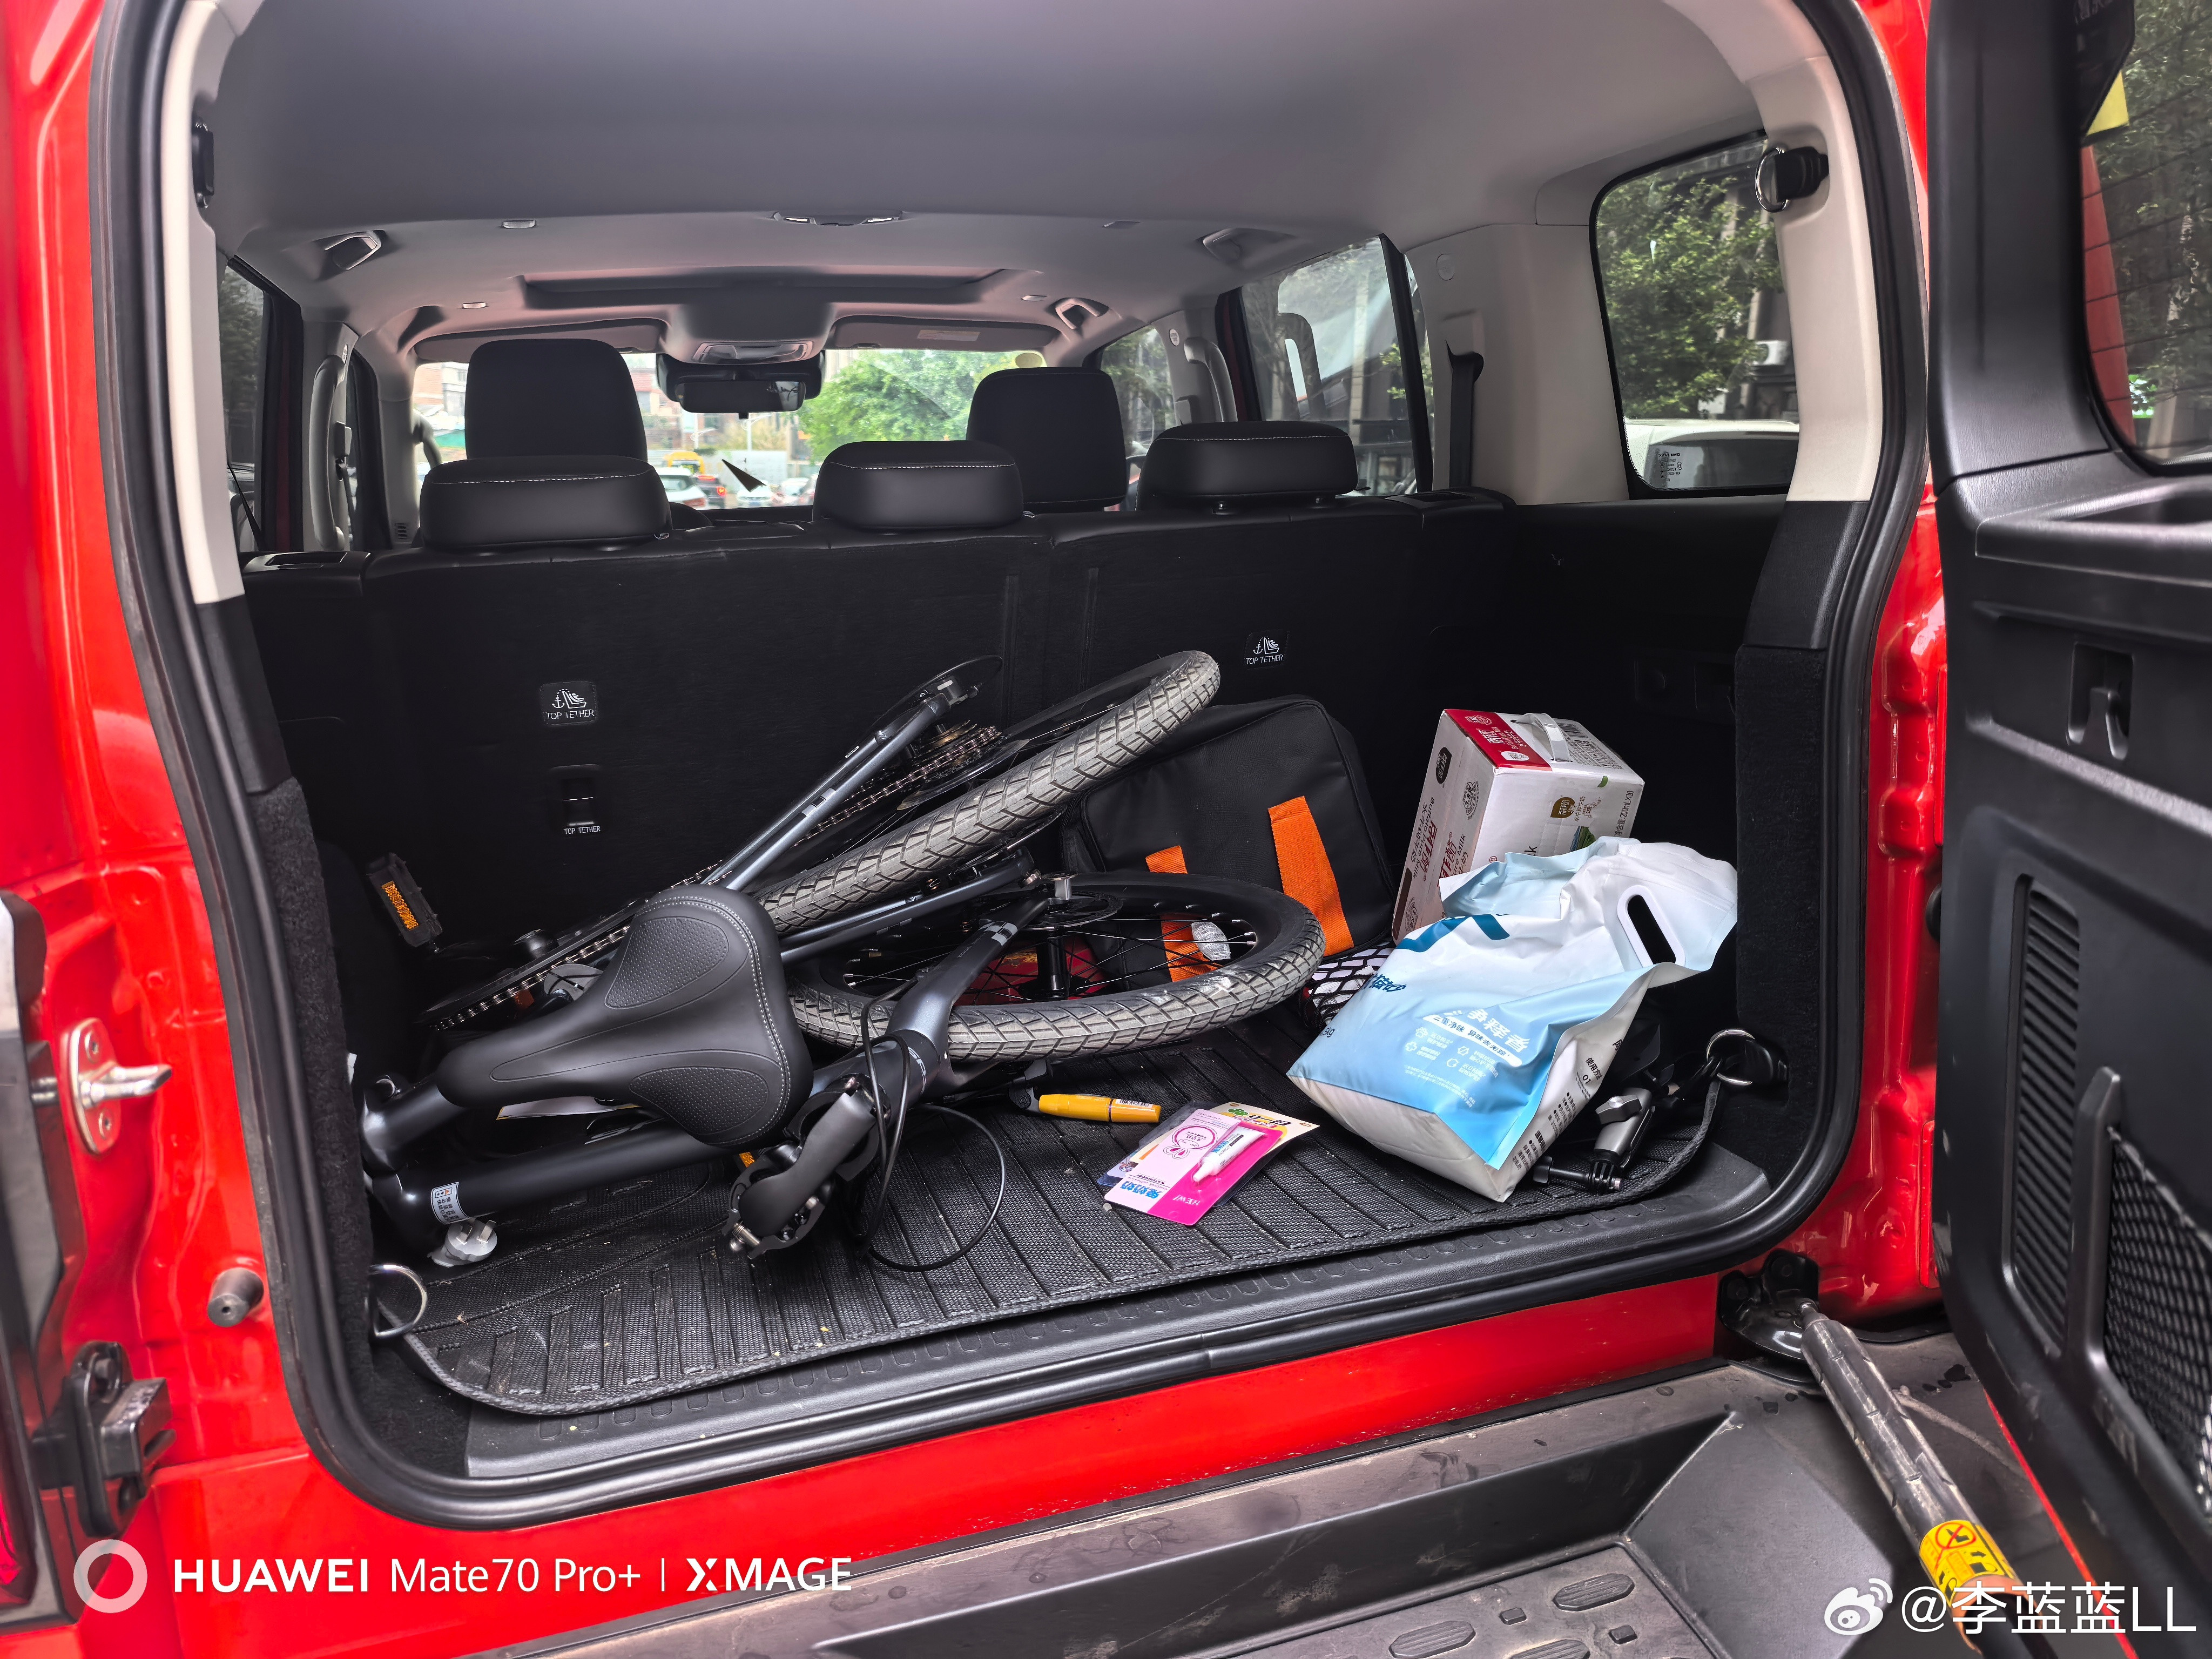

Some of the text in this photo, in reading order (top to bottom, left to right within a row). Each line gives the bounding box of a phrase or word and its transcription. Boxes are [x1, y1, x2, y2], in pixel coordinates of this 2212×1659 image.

[1246, 654, 1283, 665] TOP TETHER
[545, 709, 595, 720] TOP TETHER
[1574, 796, 1586, 822] 水牛纯牛奶
[578, 826, 601, 834] TETHER
[1411, 801, 1428, 862] 水牛纯牛奶
[1412, 796, 1435, 879] Buffalo Pure Milk
[1456, 833, 1466, 857] Milk
[1584, 1057, 1603, 1080] 使用方法
[1582, 1074, 1591, 1084] 01
[1172, 1193, 1201, 1206] NEW!
